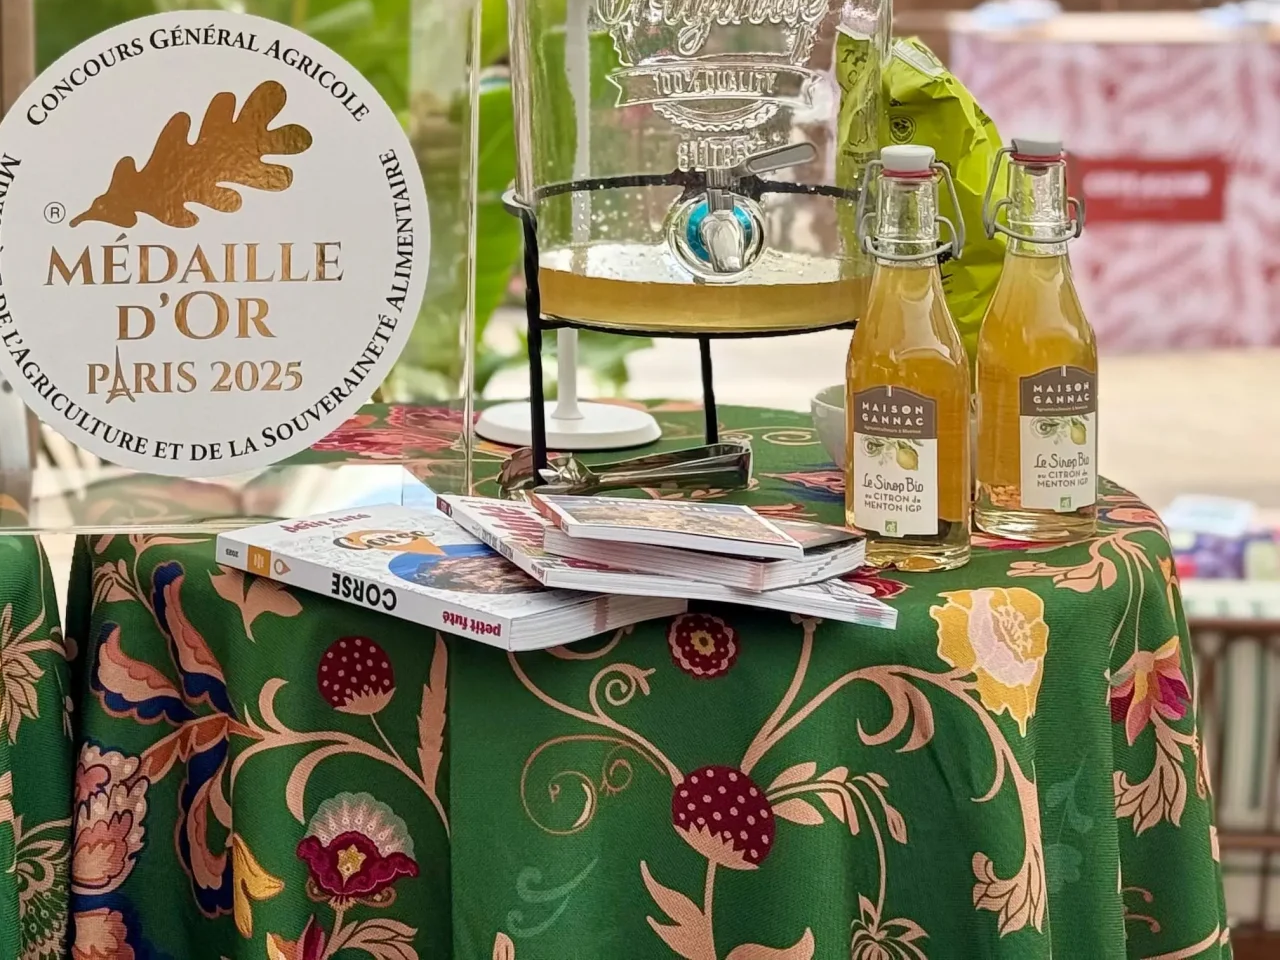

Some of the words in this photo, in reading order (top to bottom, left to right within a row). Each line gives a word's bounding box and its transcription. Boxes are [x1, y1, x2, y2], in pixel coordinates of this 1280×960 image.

[26, 36, 144, 126] CONCOURS
[149, 24, 260, 53] GÉNÉRAL
[263, 39, 370, 123] AGRICOLE
[43, 233, 344, 286] MÉDAILLE
[1, 324, 147, 455] L'AGRICULTURE
[152, 441, 184, 461] ET
[190, 443, 223, 461] DE
[228, 436, 260, 458] LA
[261, 314, 399, 448] SOUVERAINETÉ
[379, 148, 415, 314] ALIMENTAIRE
[87, 345, 197, 404] PARIS
[210, 360, 304, 393] 2025
[1033, 382, 1090, 393] MAISON
[1033, 392, 1090, 404] GANNAC
[862, 401, 924, 415] MAISON
[862, 413, 924, 426] GANNAC
[1034, 453, 1047, 468] Le
[1048, 453, 1077, 470] Sirop
[1077, 452, 1090, 466] Bio
[862, 473, 873, 488] Le
[874, 474, 905, 493] Sirop
[905, 477, 924, 493] Bio
[1037, 479, 1076, 488] MENTON
[1078, 477, 1088, 486] IGP
[1048, 470, 1080, 479] CITRON
[864, 500, 903, 512] MENTON
[905, 503, 922, 512] IGP
[873, 492, 909, 503] CITRON
[333, 530, 436, 551] Corse
[331, 572, 397, 611] CORSE
[442, 610, 468, 631] futé
[469, 619, 501, 637] petit
